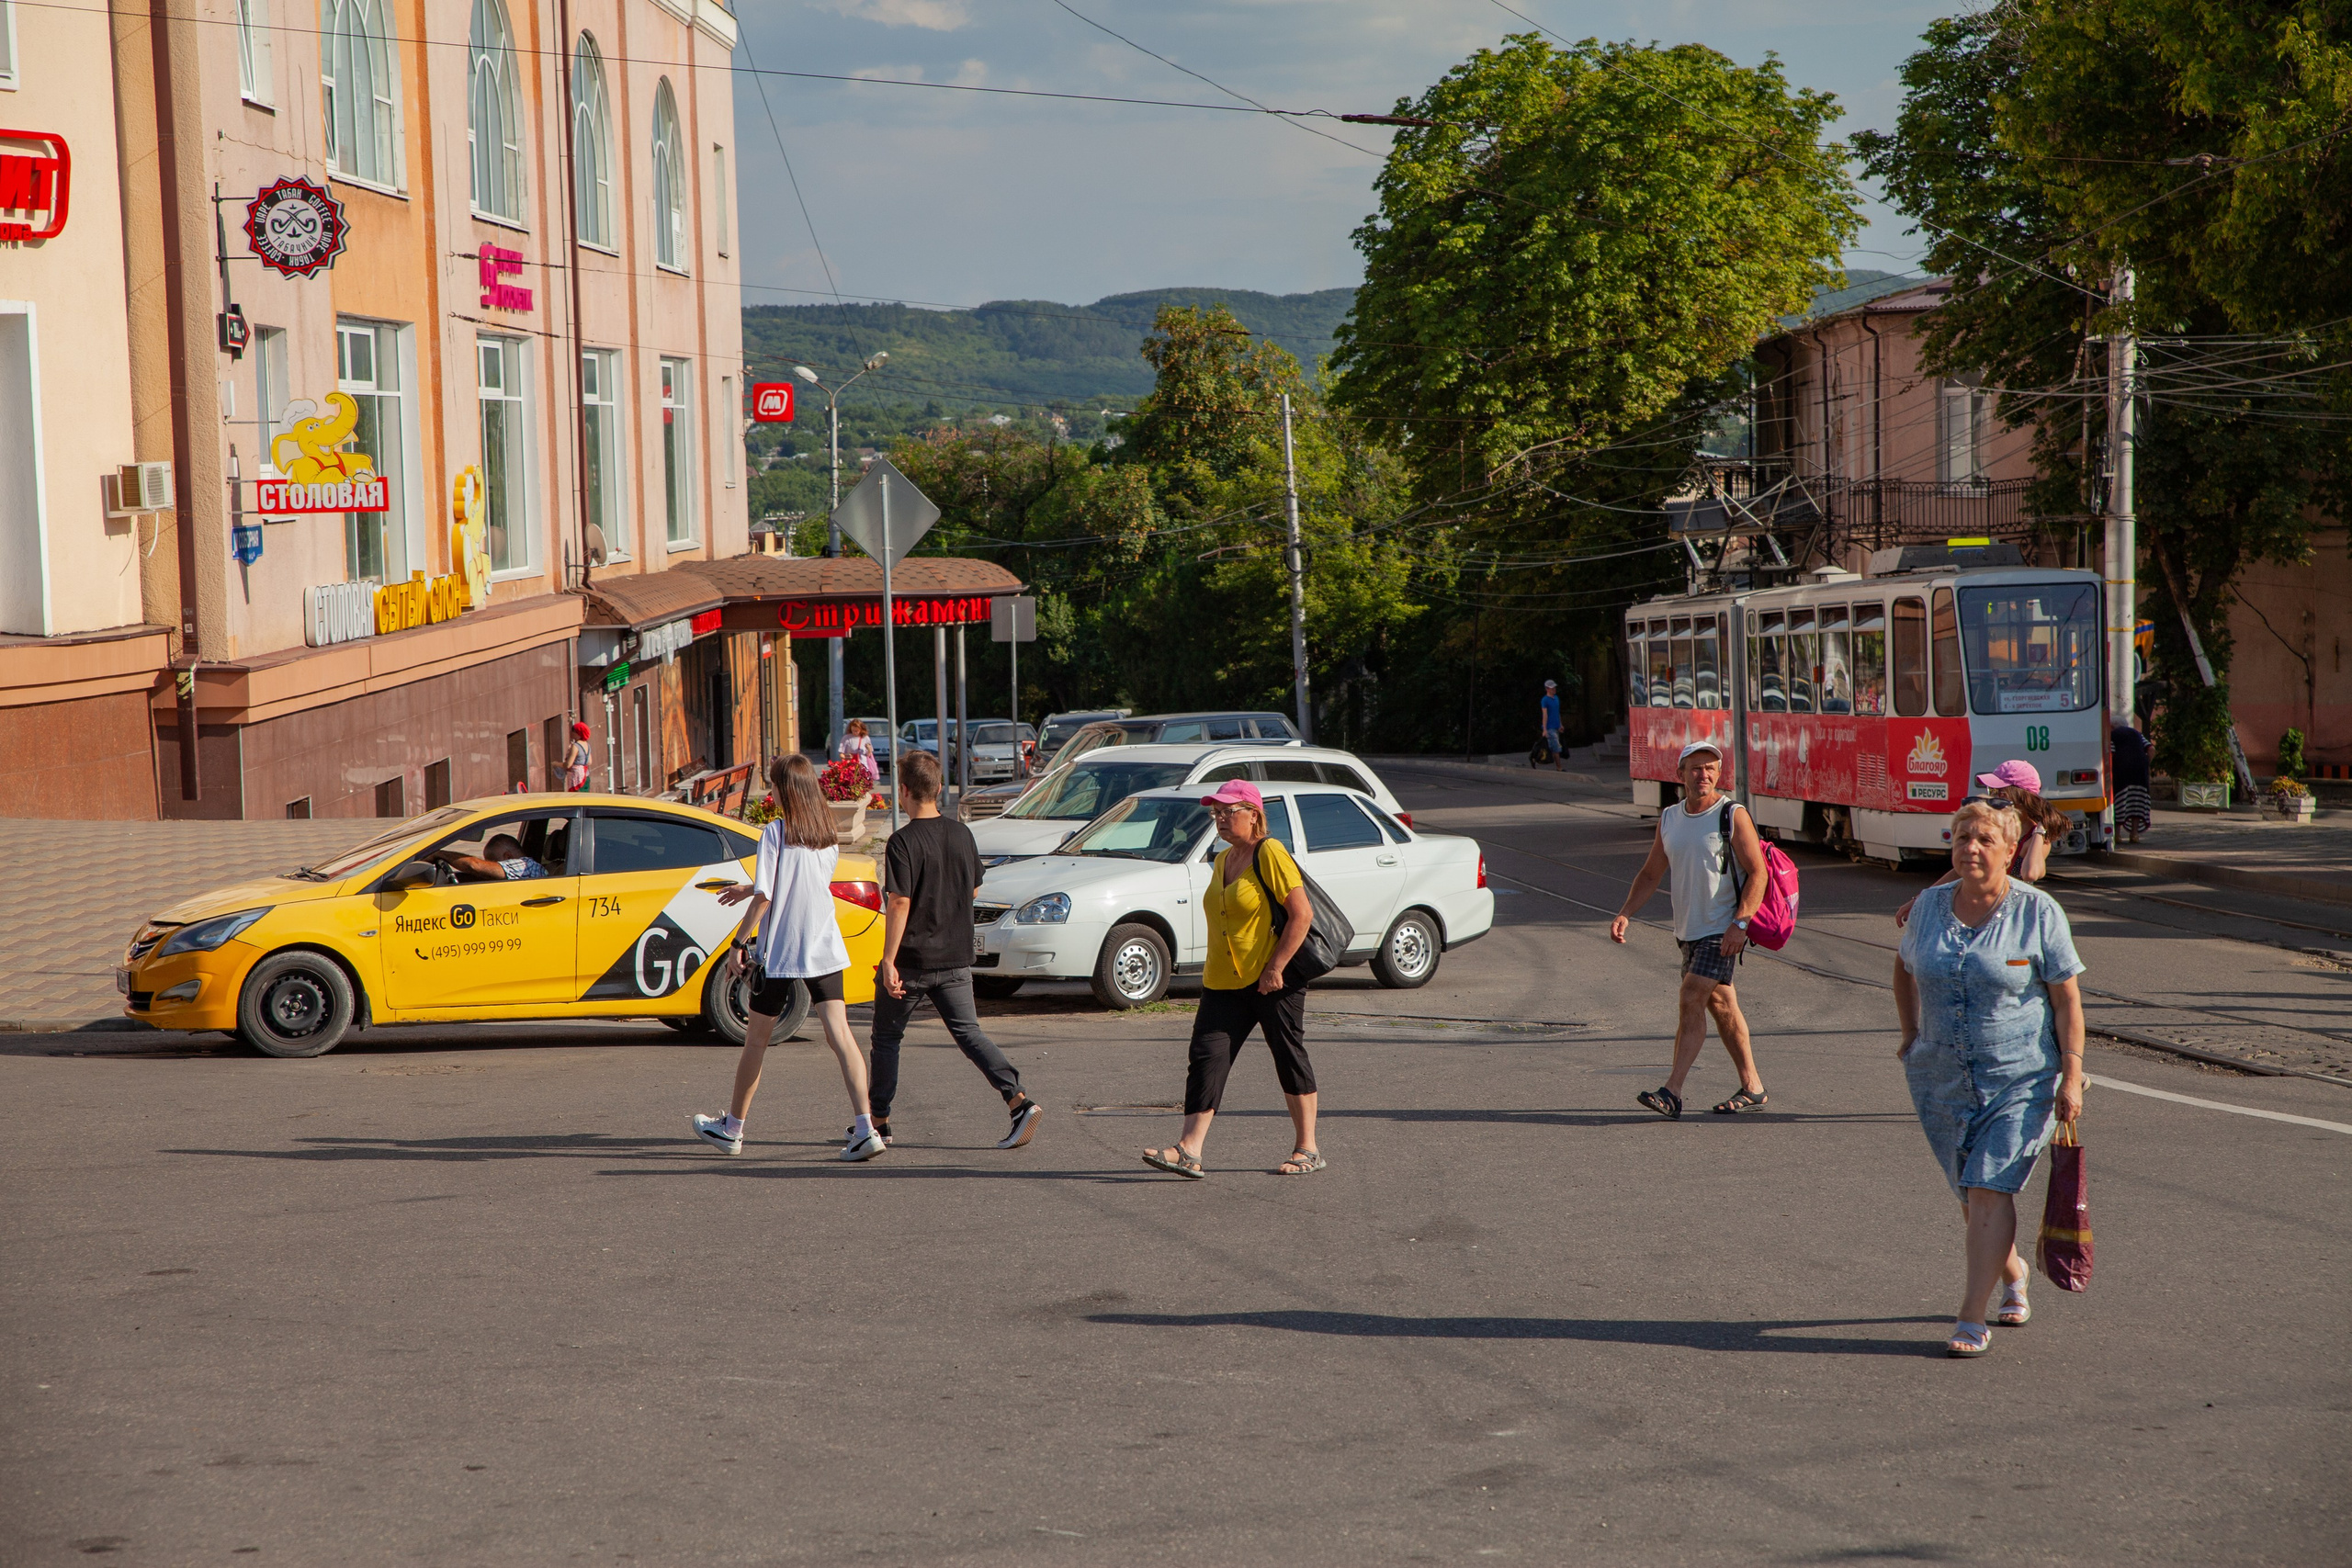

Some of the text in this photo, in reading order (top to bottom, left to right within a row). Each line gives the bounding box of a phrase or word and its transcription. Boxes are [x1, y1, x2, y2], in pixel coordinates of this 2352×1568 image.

[276, 188, 302, 200] ТАБАК
[308, 194, 333, 223] COFFEE
[256, 233, 283, 263] COFFEE
[288, 253, 315, 266] ТАБАК
[259, 480, 385, 511] СТОЛОВАЯ
[312, 570, 462, 647] СТОЛОВАЯ СЫТЫЙ СЛОН
[2060, 694, 2070, 707] 5
[2026, 725, 2050, 752] 08
[1908, 756, 1947, 775] Благояр
[1917, 788, 1947, 799] РЕСУРС
[589, 896, 622, 918] 734
[395, 908, 520, 934] Яндекс Go Такси
[431, 937, 522, 961] (495) 999 99 99
[973, 937, 982, 948] 26
